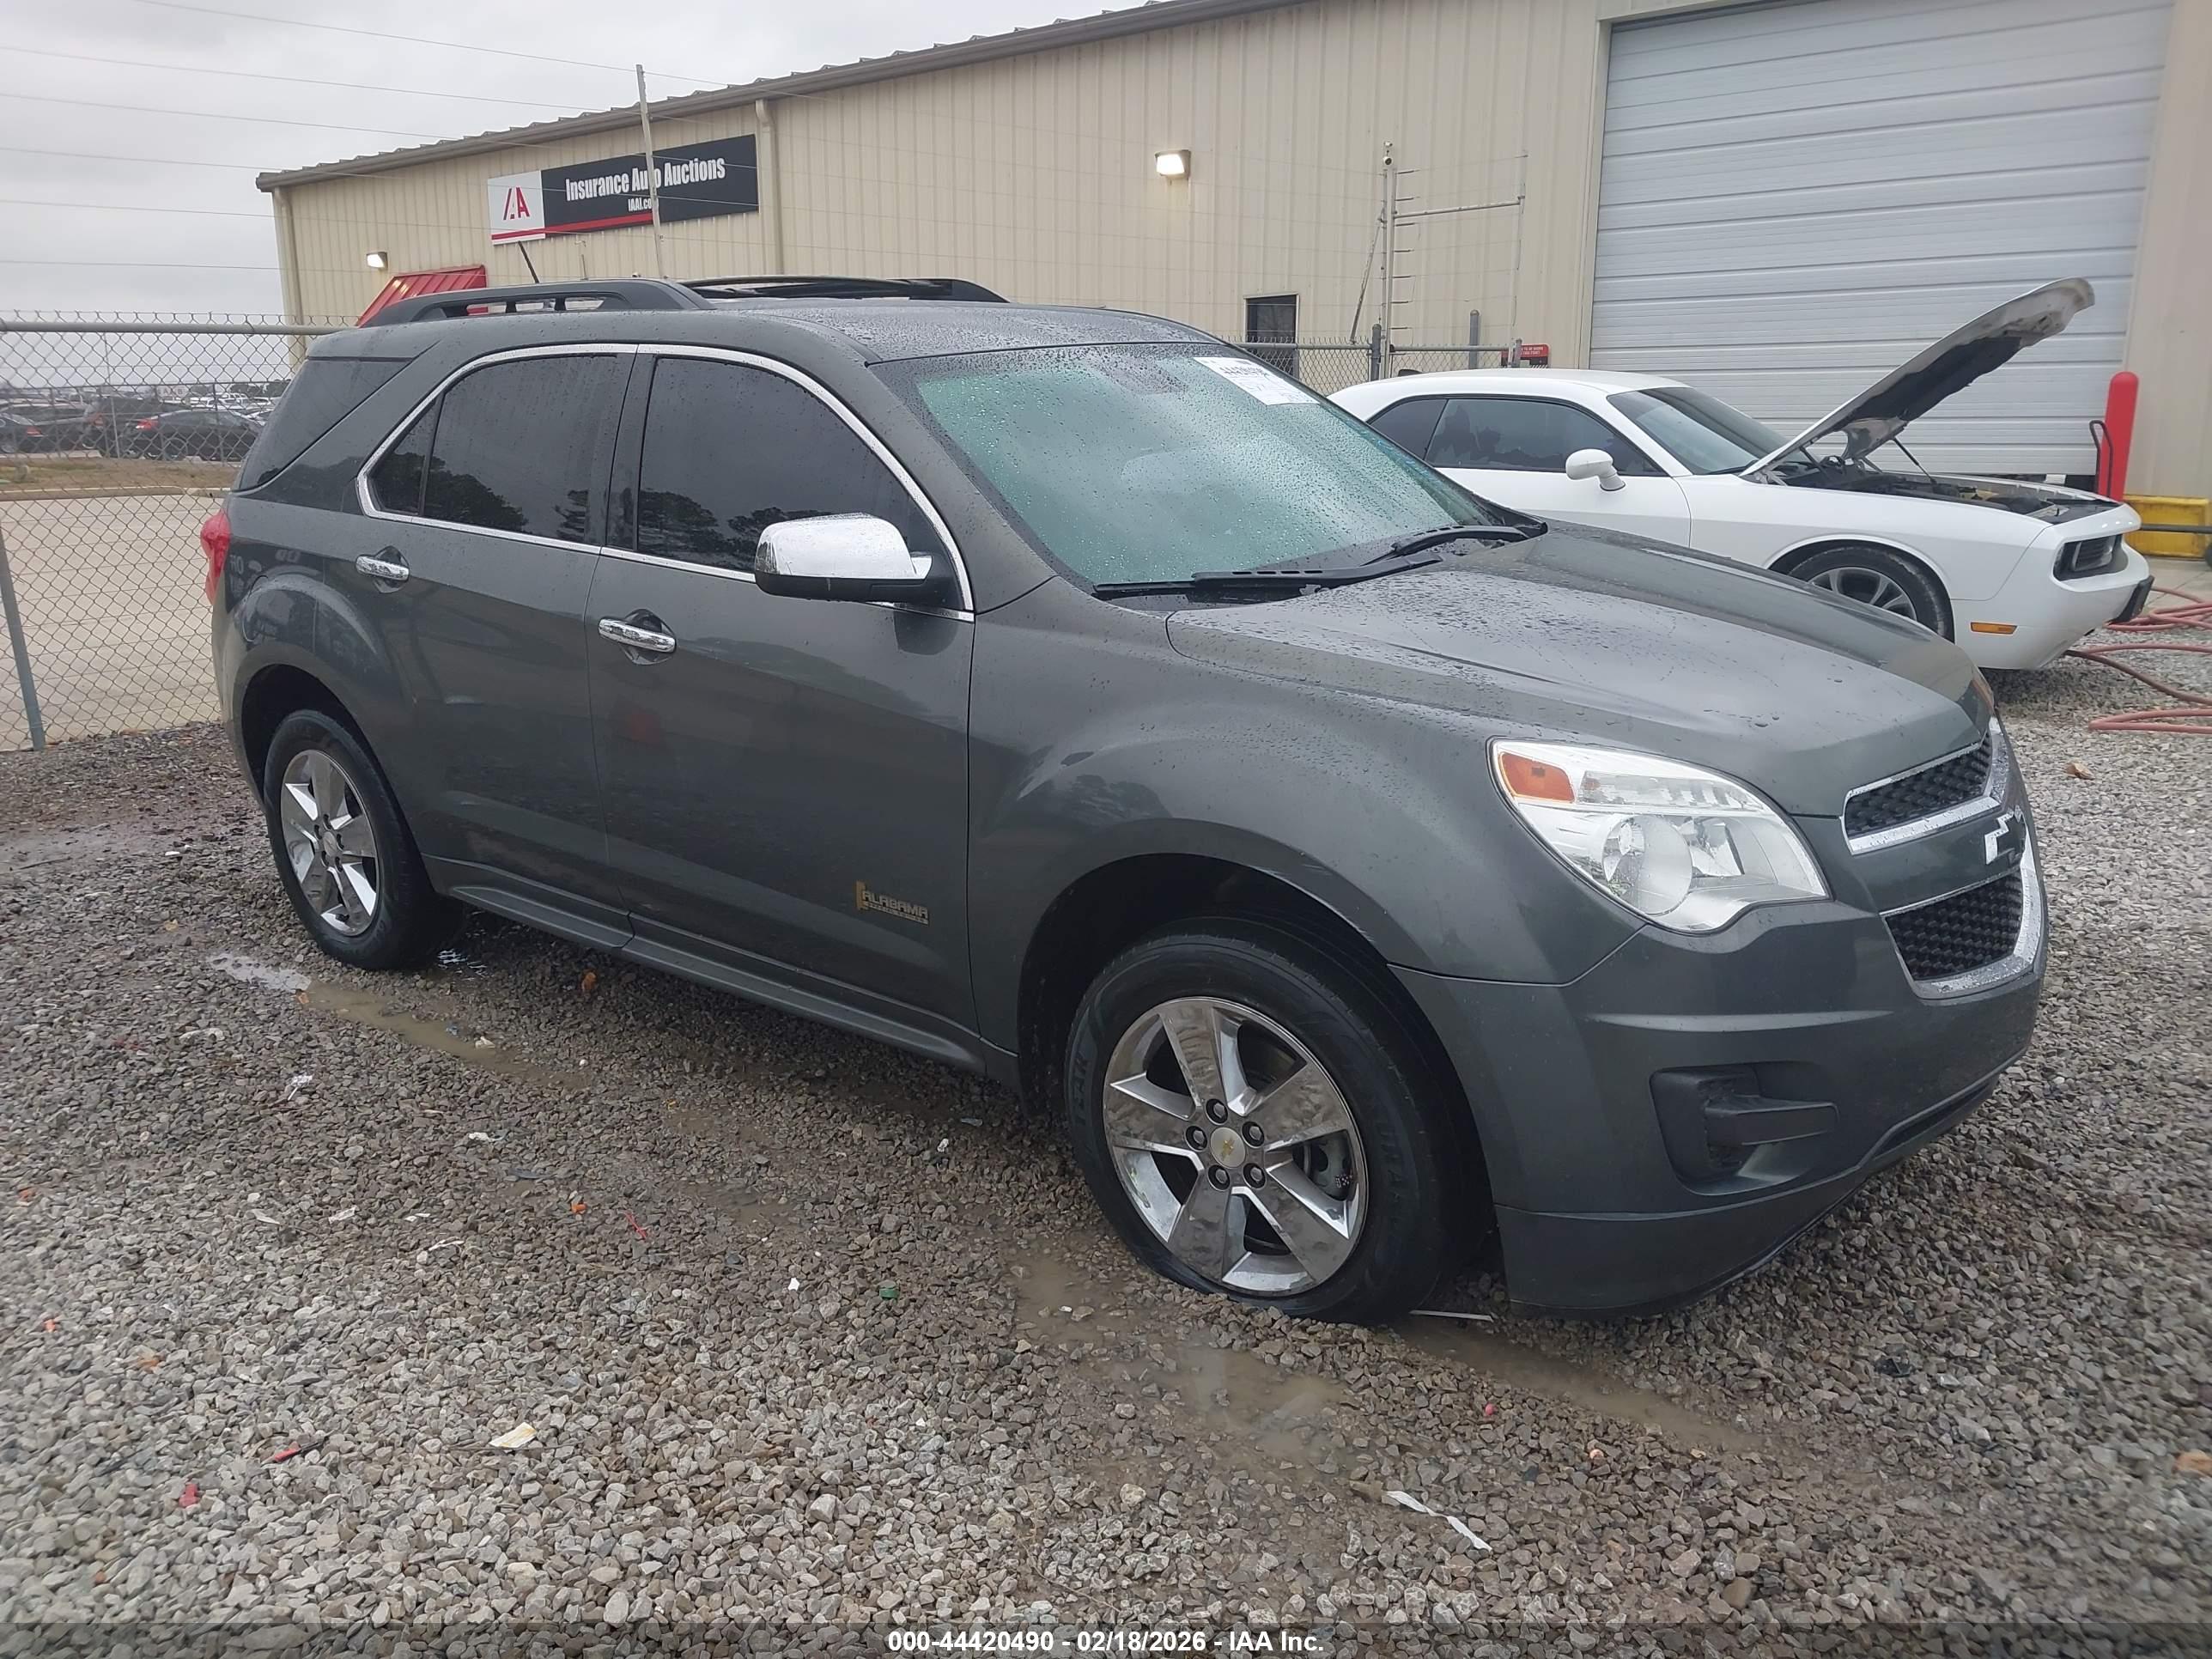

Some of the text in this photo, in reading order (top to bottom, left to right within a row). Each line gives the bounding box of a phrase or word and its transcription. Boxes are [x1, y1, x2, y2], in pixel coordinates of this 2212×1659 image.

[565, 158, 726, 202] Insurance Auo Auctions
[628, 197, 659, 212] IAAI.co
[862, 890, 929, 920] ALABAMA
